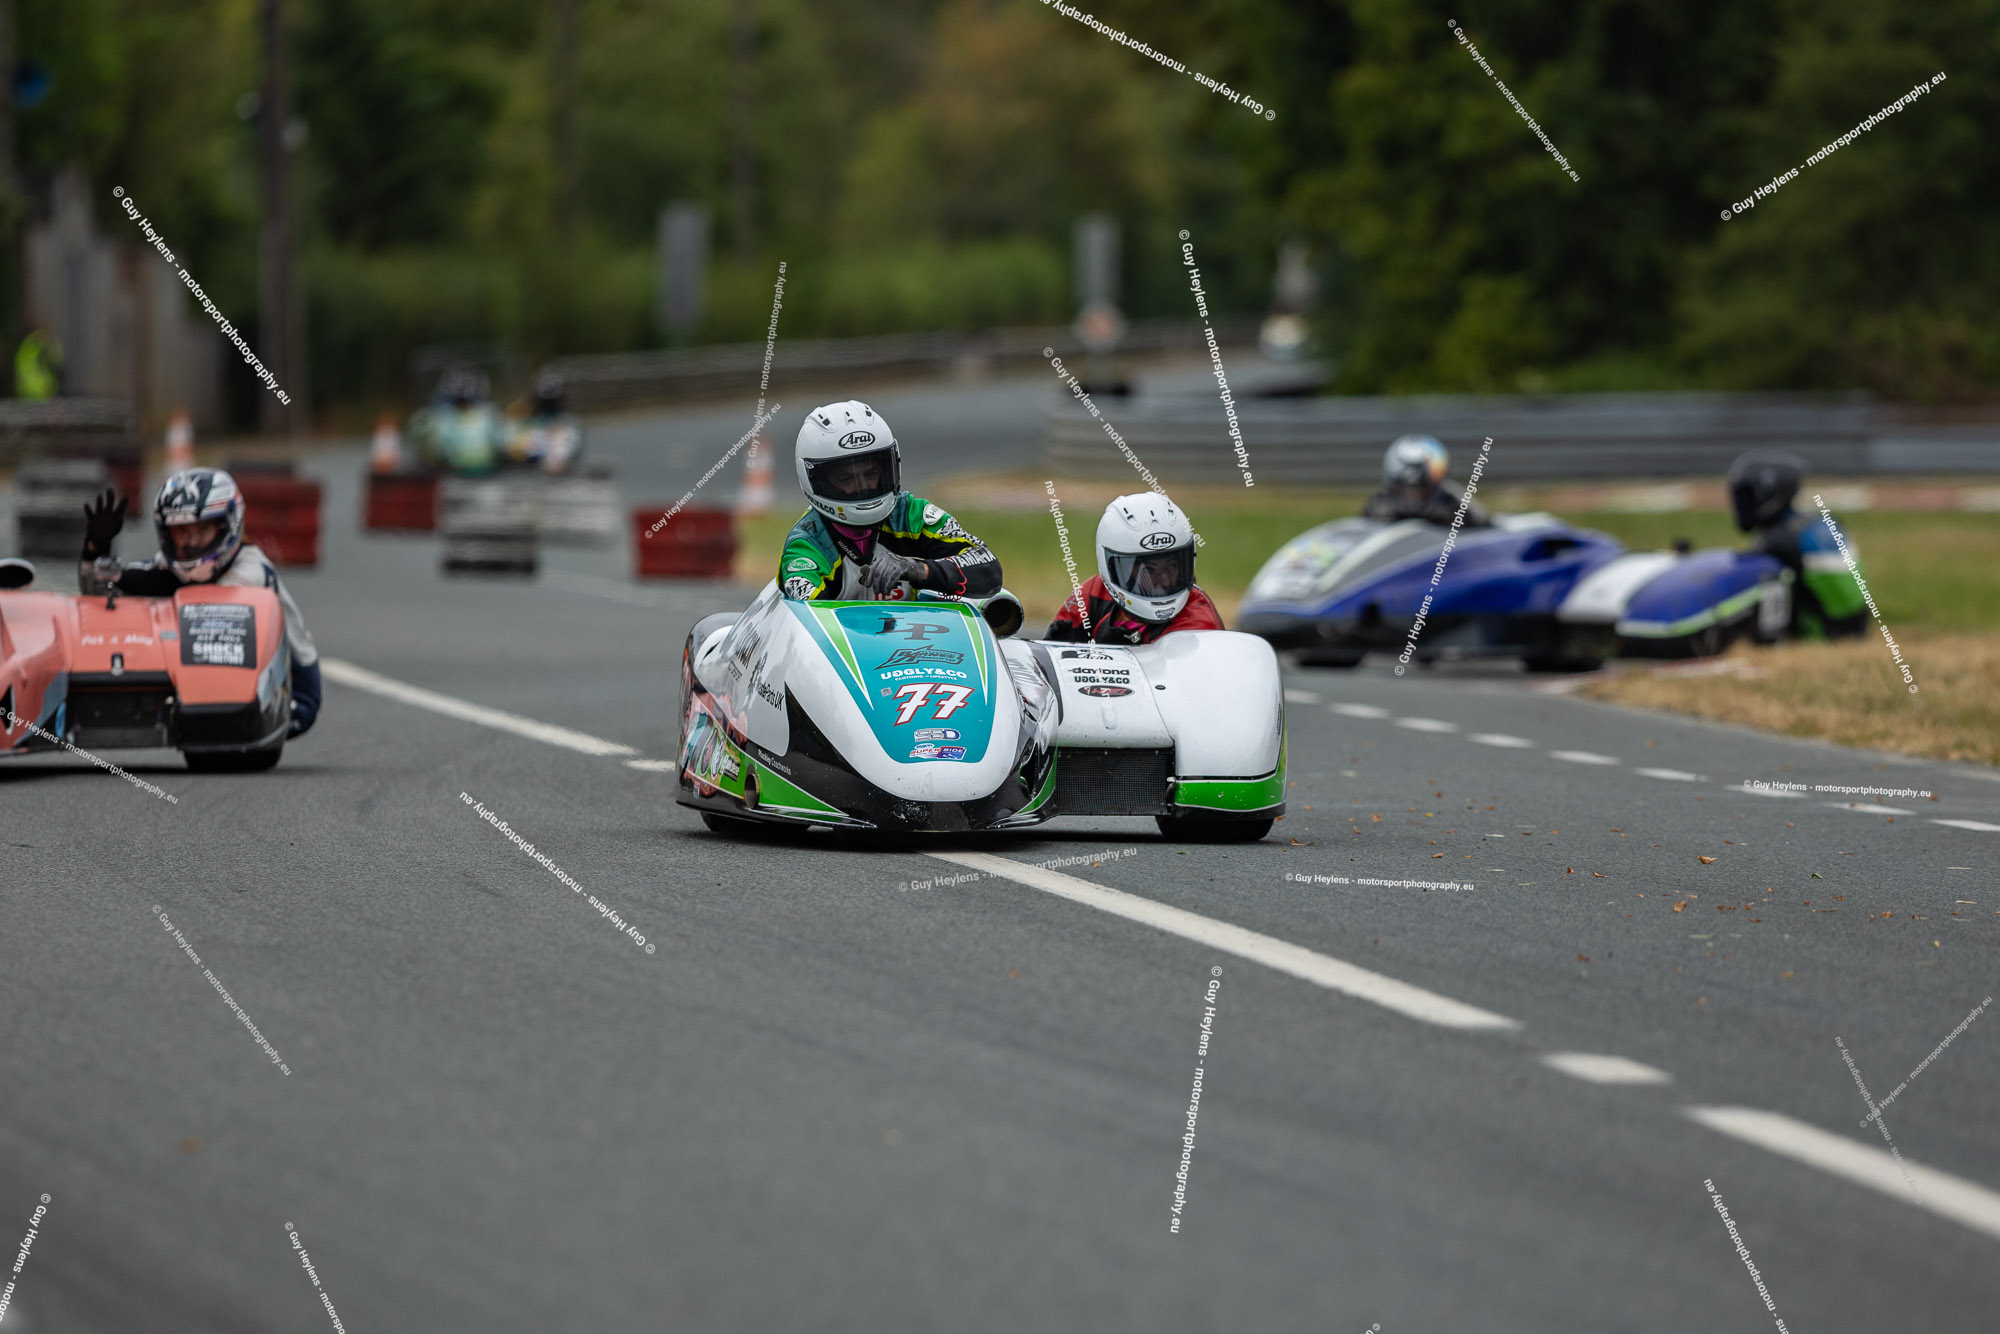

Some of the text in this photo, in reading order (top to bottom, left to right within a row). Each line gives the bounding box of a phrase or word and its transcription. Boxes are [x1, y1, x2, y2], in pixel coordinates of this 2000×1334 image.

[844, 432, 872, 447] Arai
[1144, 534, 1172, 547] Arai
[1069, 667, 1130, 676] dayona
[892, 682, 976, 727] 77
